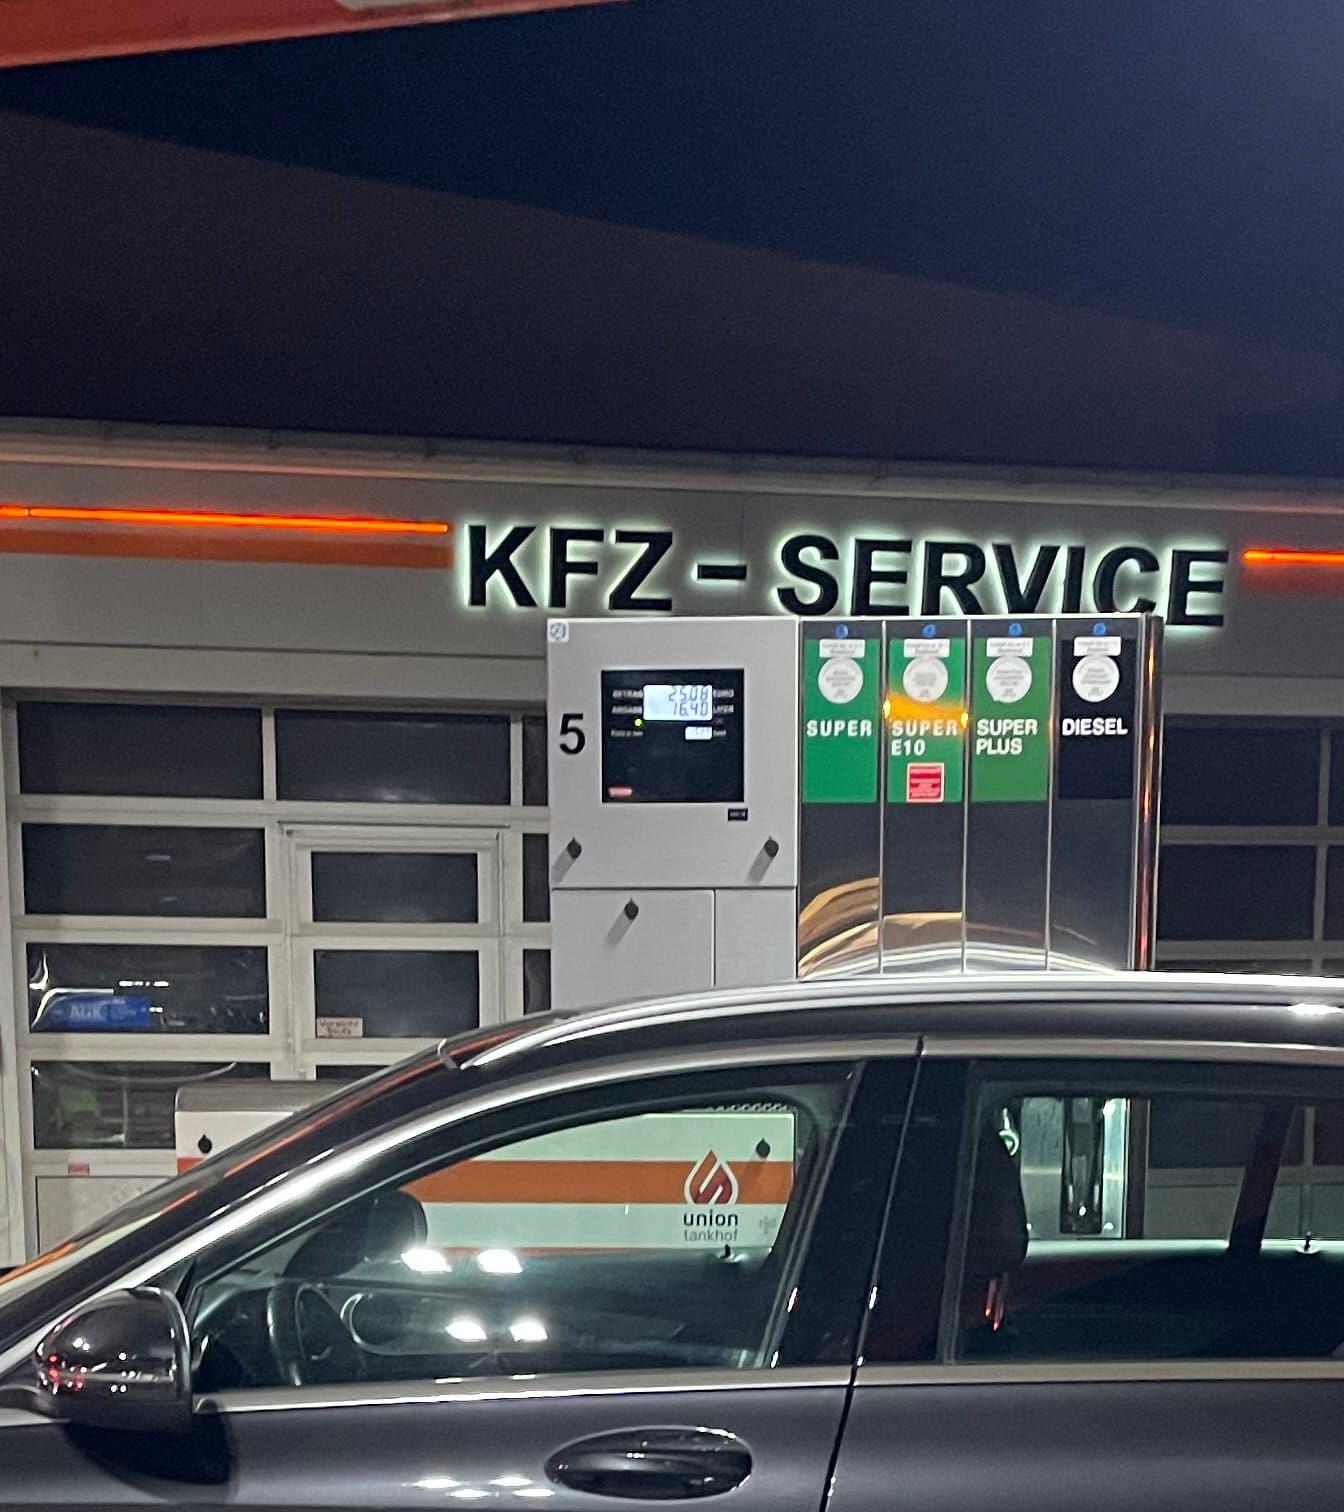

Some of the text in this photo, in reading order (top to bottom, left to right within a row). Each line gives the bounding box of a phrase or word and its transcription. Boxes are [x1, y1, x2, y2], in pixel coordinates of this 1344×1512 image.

[559, 712, 587, 756] 5
[806, 719, 873, 738] SUPER
[891, 719, 959, 738] SUPER
[976, 718, 1039, 737] SUPER
[1061, 717, 1129, 736] DIESEL
[890, 738, 927, 756] E10
[975, 737, 1024, 756] PLUS
[683, 1208, 739, 1227] union
[684, 1228, 739, 1242] tankhof
